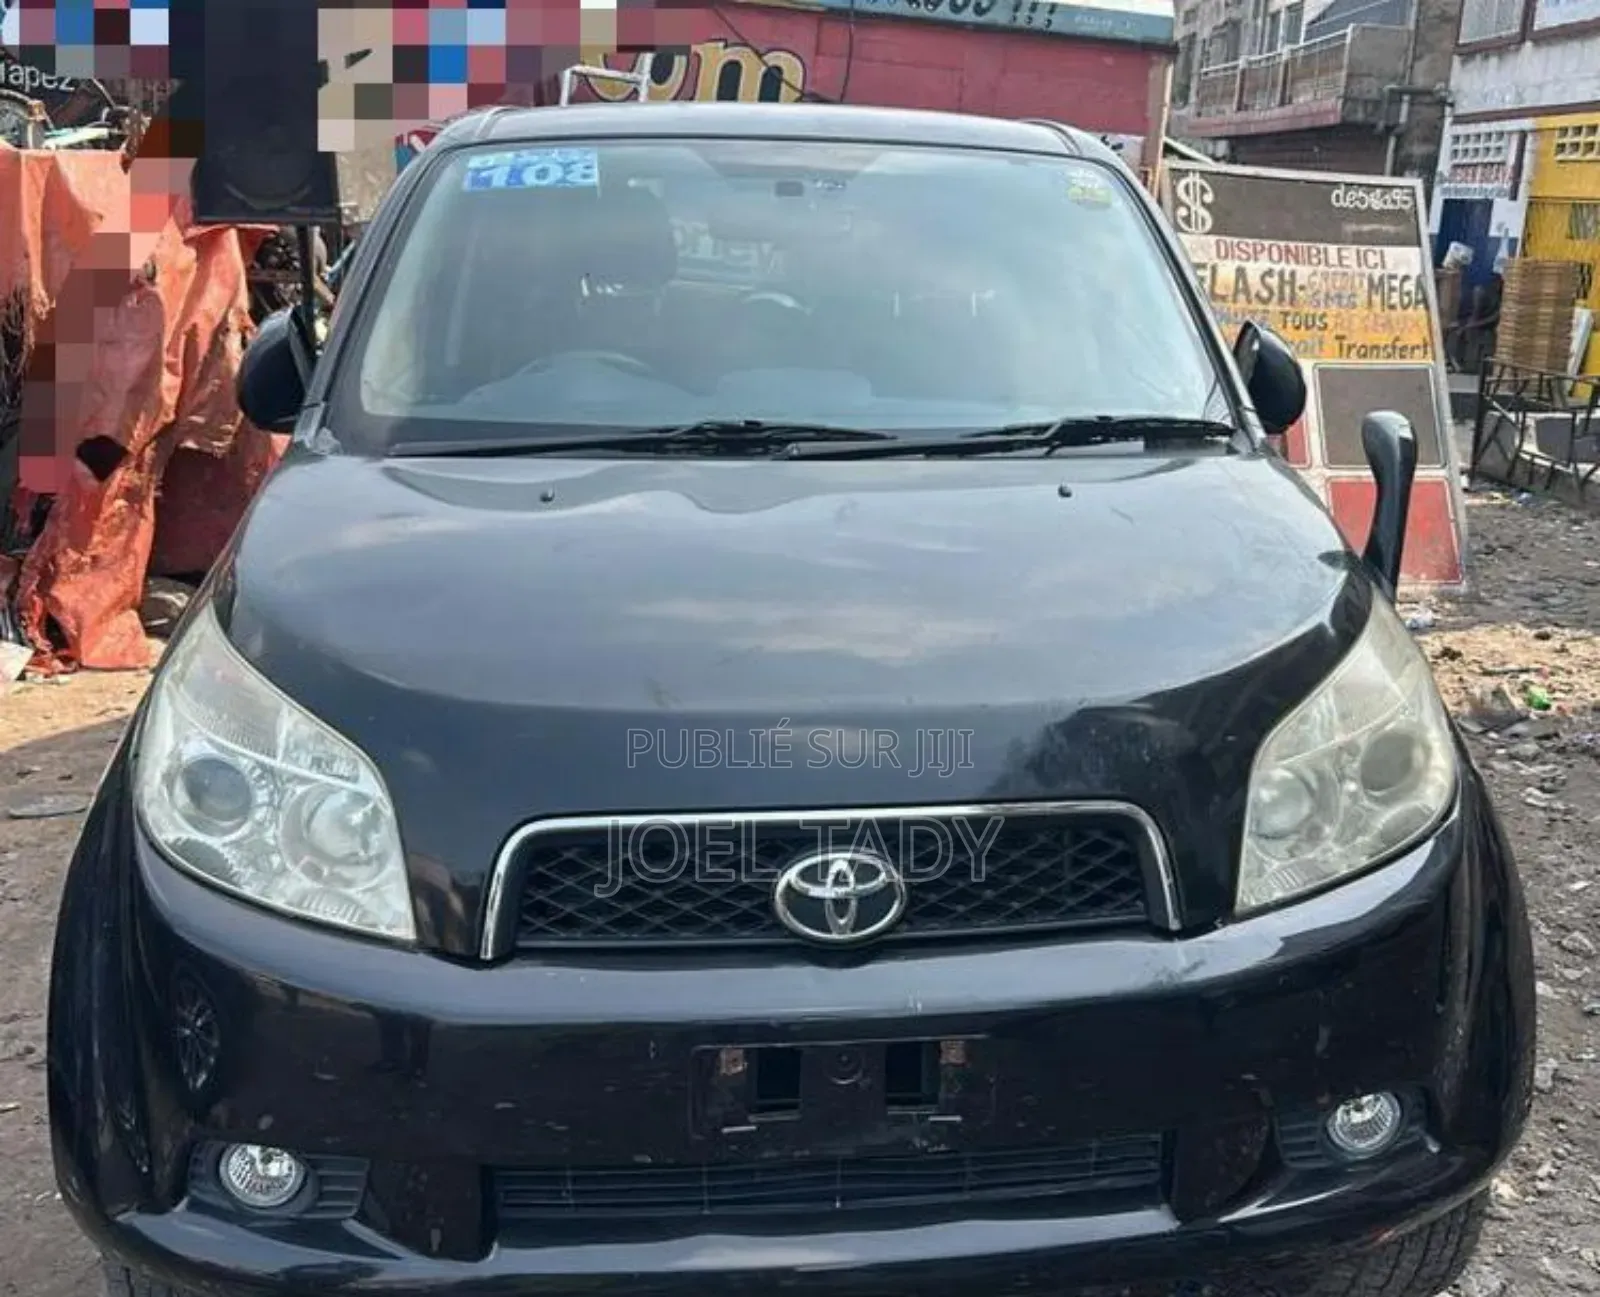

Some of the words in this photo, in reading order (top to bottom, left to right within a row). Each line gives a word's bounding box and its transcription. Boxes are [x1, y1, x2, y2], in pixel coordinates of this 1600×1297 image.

[1214, 238, 1351, 269] DISPONIBLE
[1356, 247, 1386, 269] ICI
[1366, 271, 1428, 311] MEGA
[1280, 311, 1328, 331] TOUS
[1334, 334, 1429, 360] Transfert
